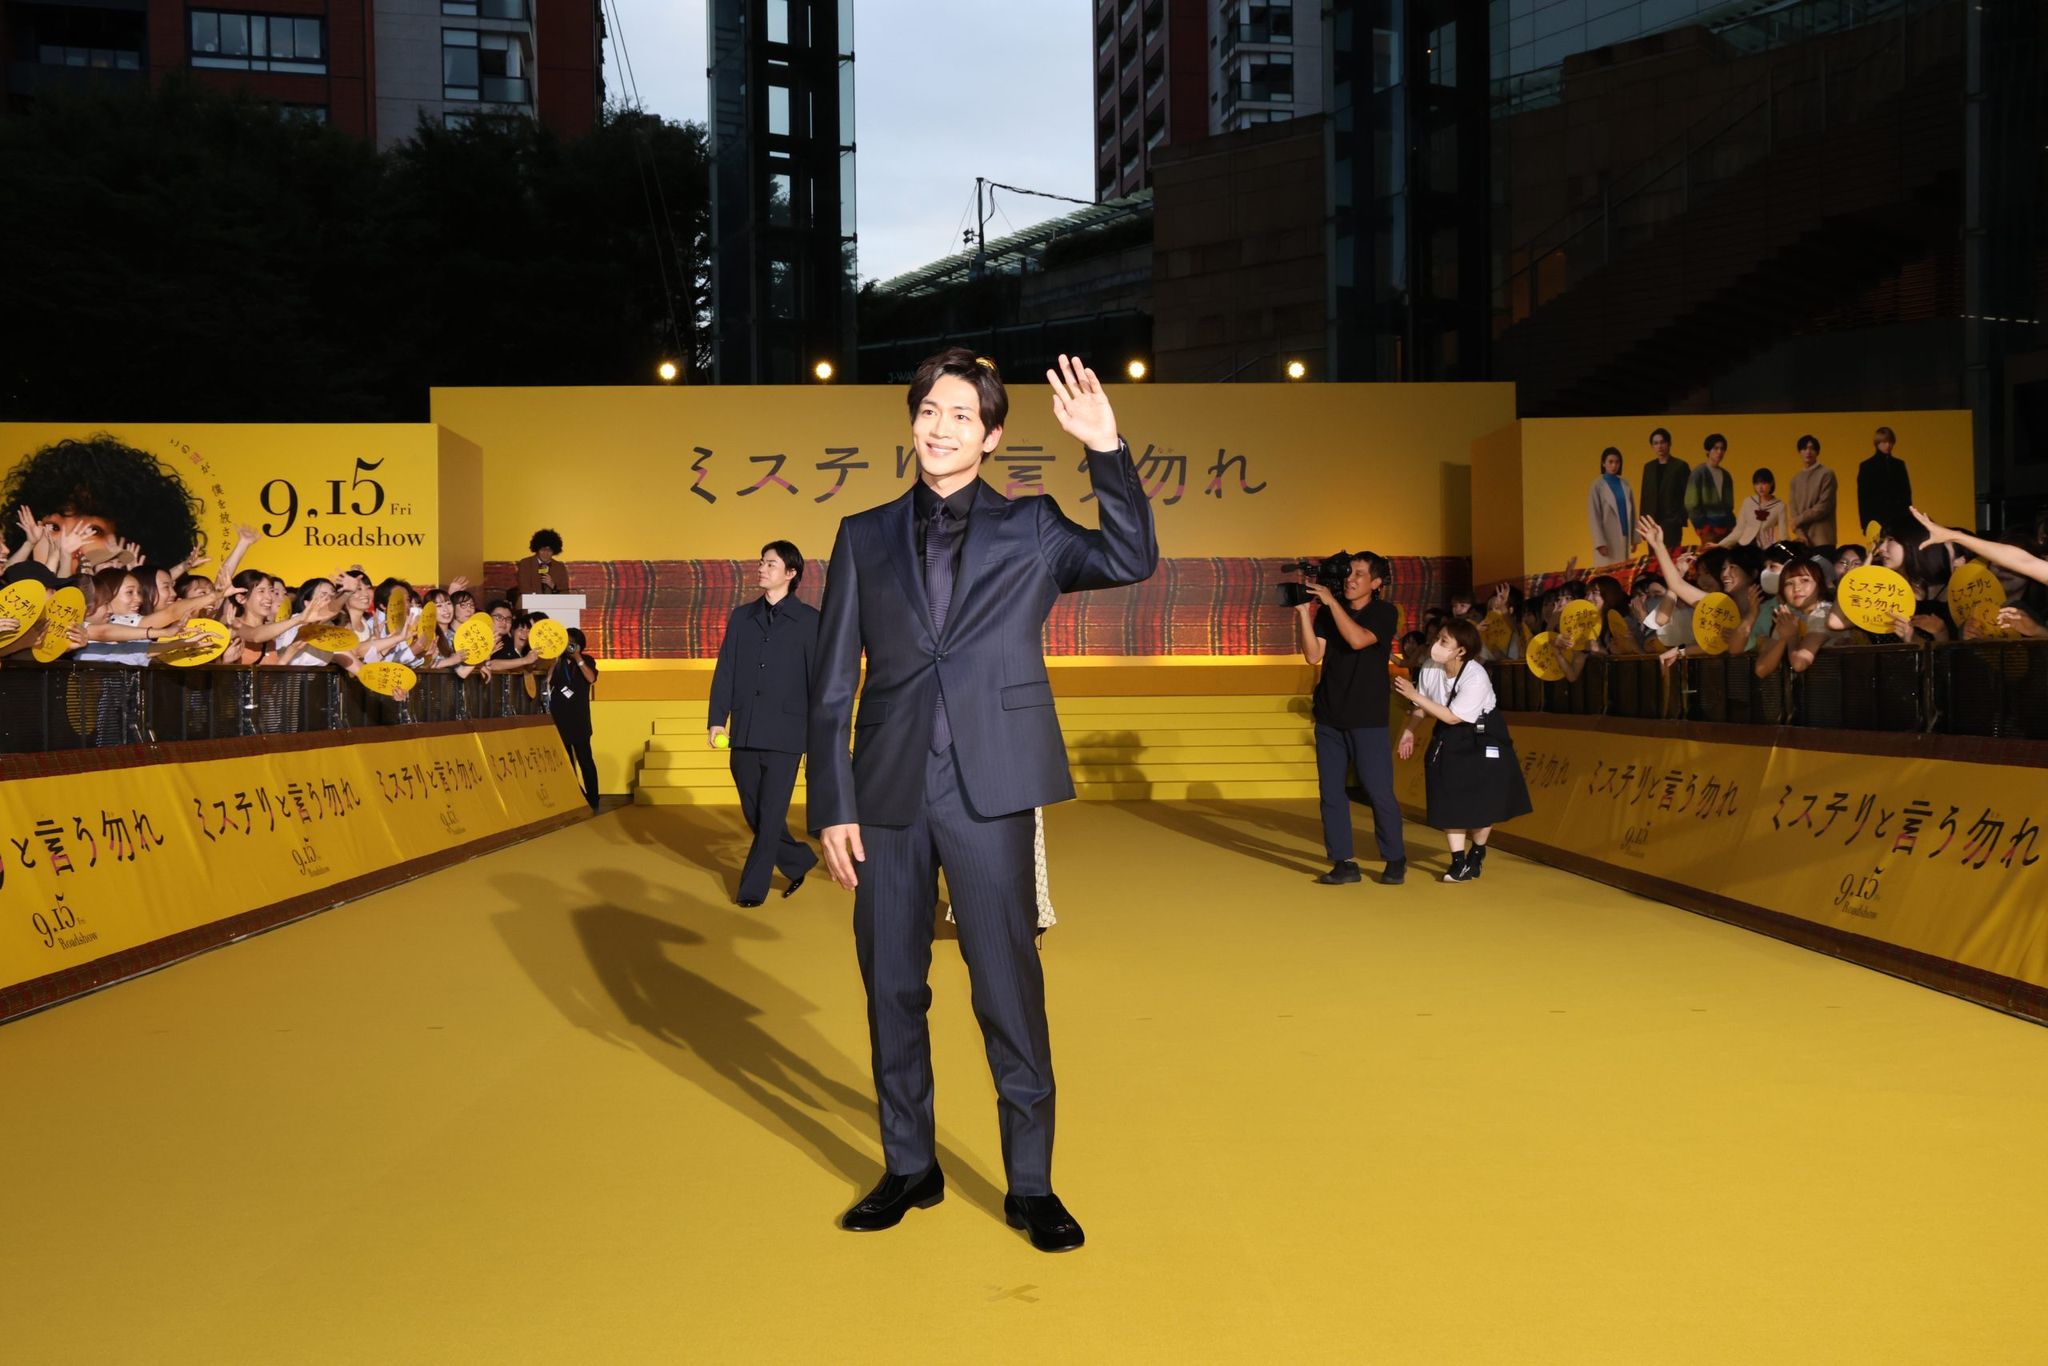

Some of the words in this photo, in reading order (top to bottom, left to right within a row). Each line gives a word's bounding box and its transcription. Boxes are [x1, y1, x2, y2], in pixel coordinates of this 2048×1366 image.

[887, 368, 916, 384] J-WA
[259, 457, 385, 538] 9.15
[390, 503, 412, 516] Fri
[690, 444, 1267, 505] ミステリ言勿れ
[304, 526, 425, 547] Roadshow
[1849, 578, 1906, 597] ミステリと
[1849, 594, 1905, 613] 言う勿れ
[376, 757, 483, 804] ミステリと言う勿れ
[1588, 760, 1739, 819] ミステリと言う勿れ
[194, 778, 361, 842] ミステリと言う勿れ
[1772, 785, 2040, 870] ミステリと言う勿れ
[0, 809, 164, 890] と言う勿れ
[1834, 866, 1885, 906] 9.15
[32, 892, 76, 948] 9.15
[58, 931, 99, 950] Roadshow
